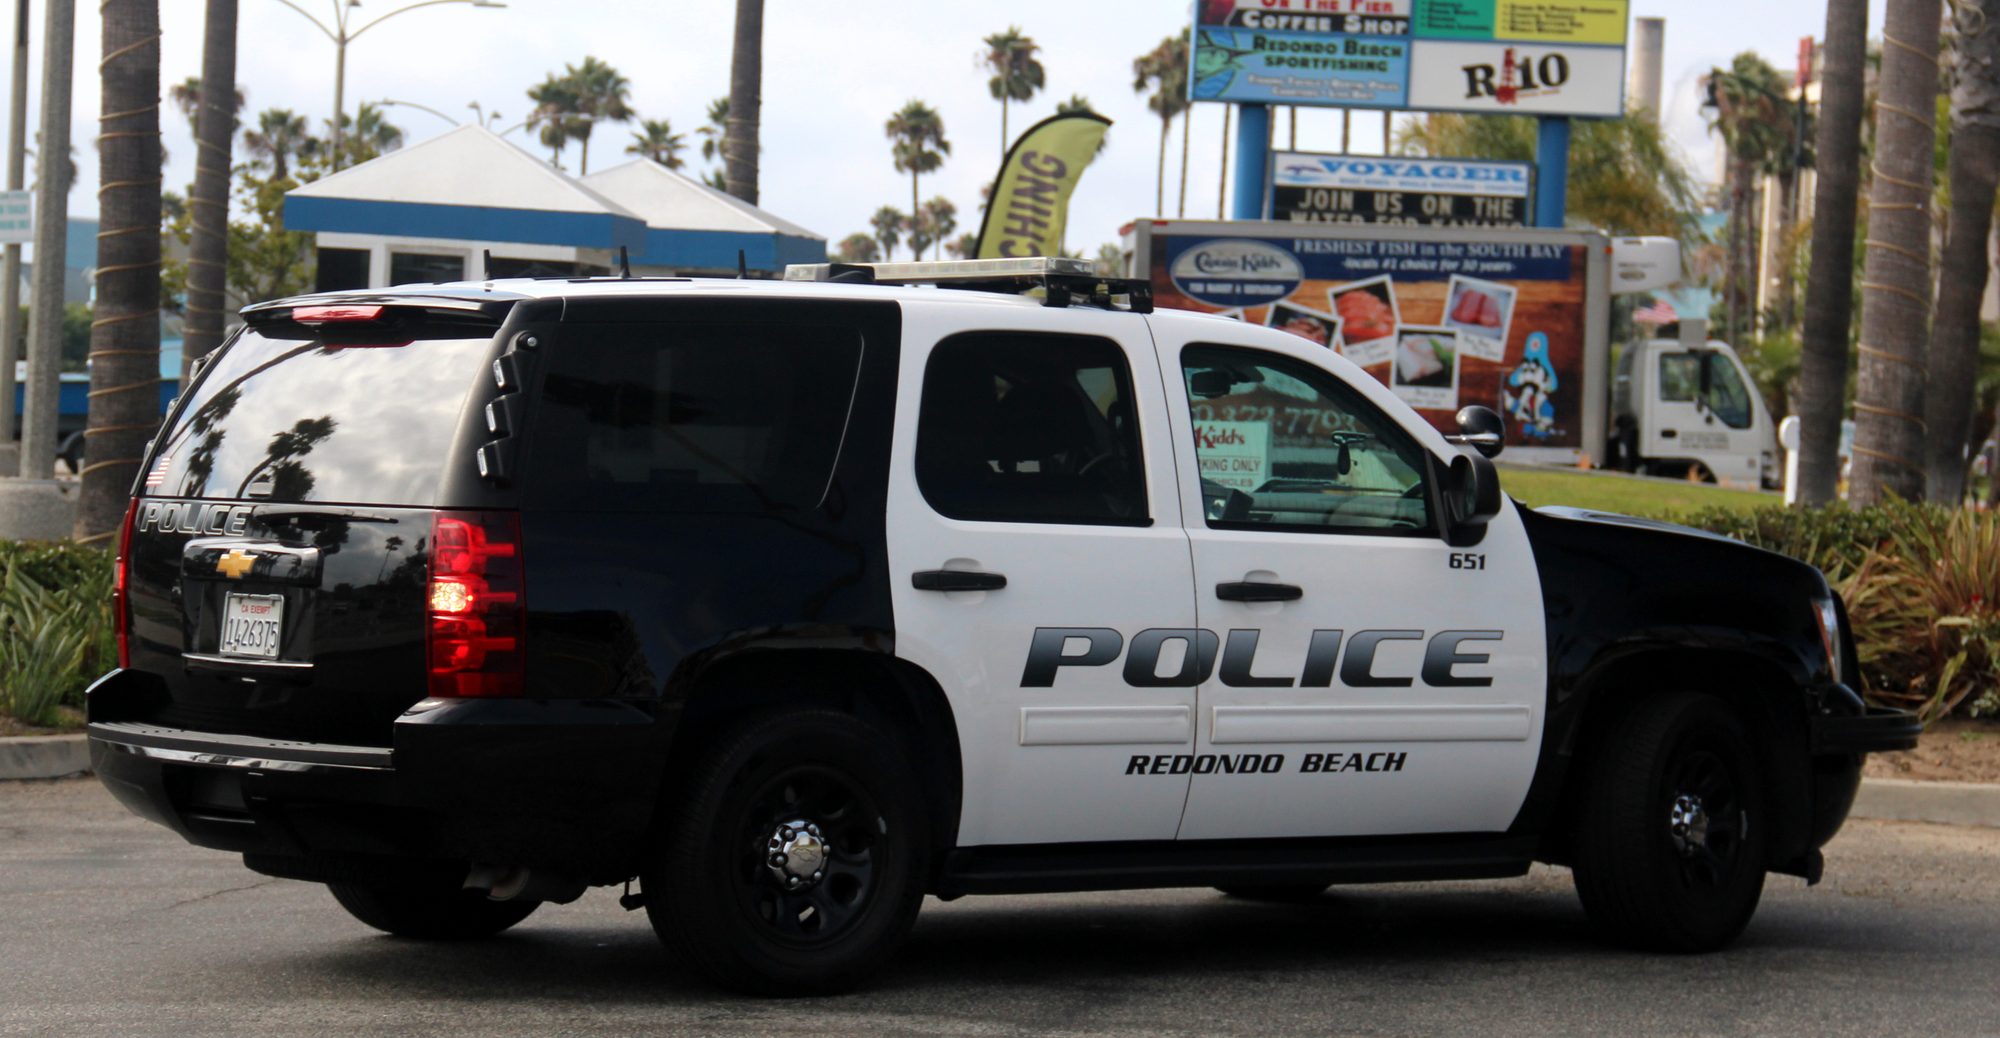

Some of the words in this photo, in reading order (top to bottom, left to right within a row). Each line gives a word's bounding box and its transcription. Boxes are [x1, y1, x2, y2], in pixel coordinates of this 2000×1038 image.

[1242, 10, 1331, 32] COFFEE
[1344, 14, 1408, 34] SHOP
[1252, 33, 1337, 54] REDONDO
[1344, 37, 1403, 57] BEACH
[1264, 55, 1389, 72] SPORTFISHING
[1317, 159, 1524, 182] VOYAGER
[1298, 188, 1353, 211] JOIN
[1374, 192, 1403, 214] US
[1421, 194, 1452, 217] ON
[1473, 196, 1514, 220] THE
[1293, 239, 1374, 254] FRESHEST
[1379, 240, 1416, 255] FISH
[1420, 242, 1436, 256] in
[1439, 242, 1464, 257] the
[1467, 243, 1526, 258] SOUTH
[1530, 244, 1564, 259] BAY
[1199, 459, 1228, 471] KING
[1232, 459, 1261, 471] ONLY
[140, 502, 252, 536] POLICE
[1449, 552, 1485, 570] 651
[226, 618, 278, 649] 1426375
[1019, 627, 1504, 688] POLICE
[1124, 753, 1285, 775] REDONDO
[1299, 752, 1407, 774] BEACH
